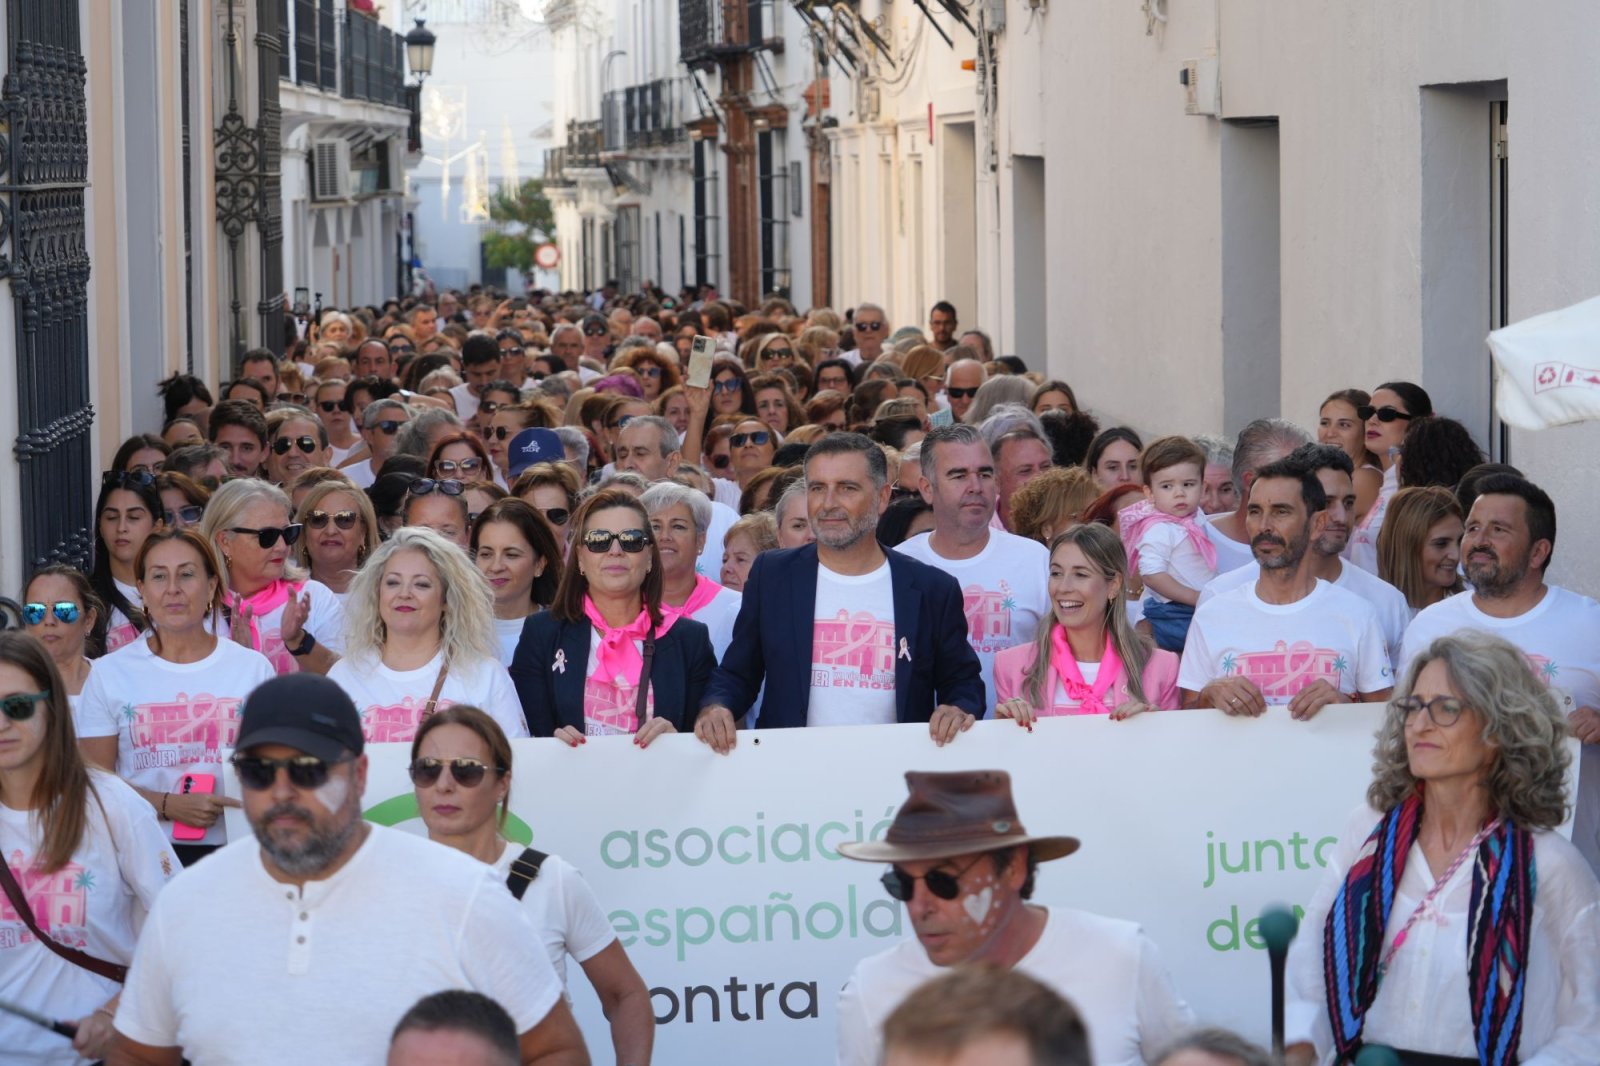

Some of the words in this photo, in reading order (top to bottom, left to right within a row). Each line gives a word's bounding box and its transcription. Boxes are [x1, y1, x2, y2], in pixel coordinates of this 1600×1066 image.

[833, 680, 854, 688] EN
[607, 884, 903, 961] española
[603, 976, 819, 1025] ontra
